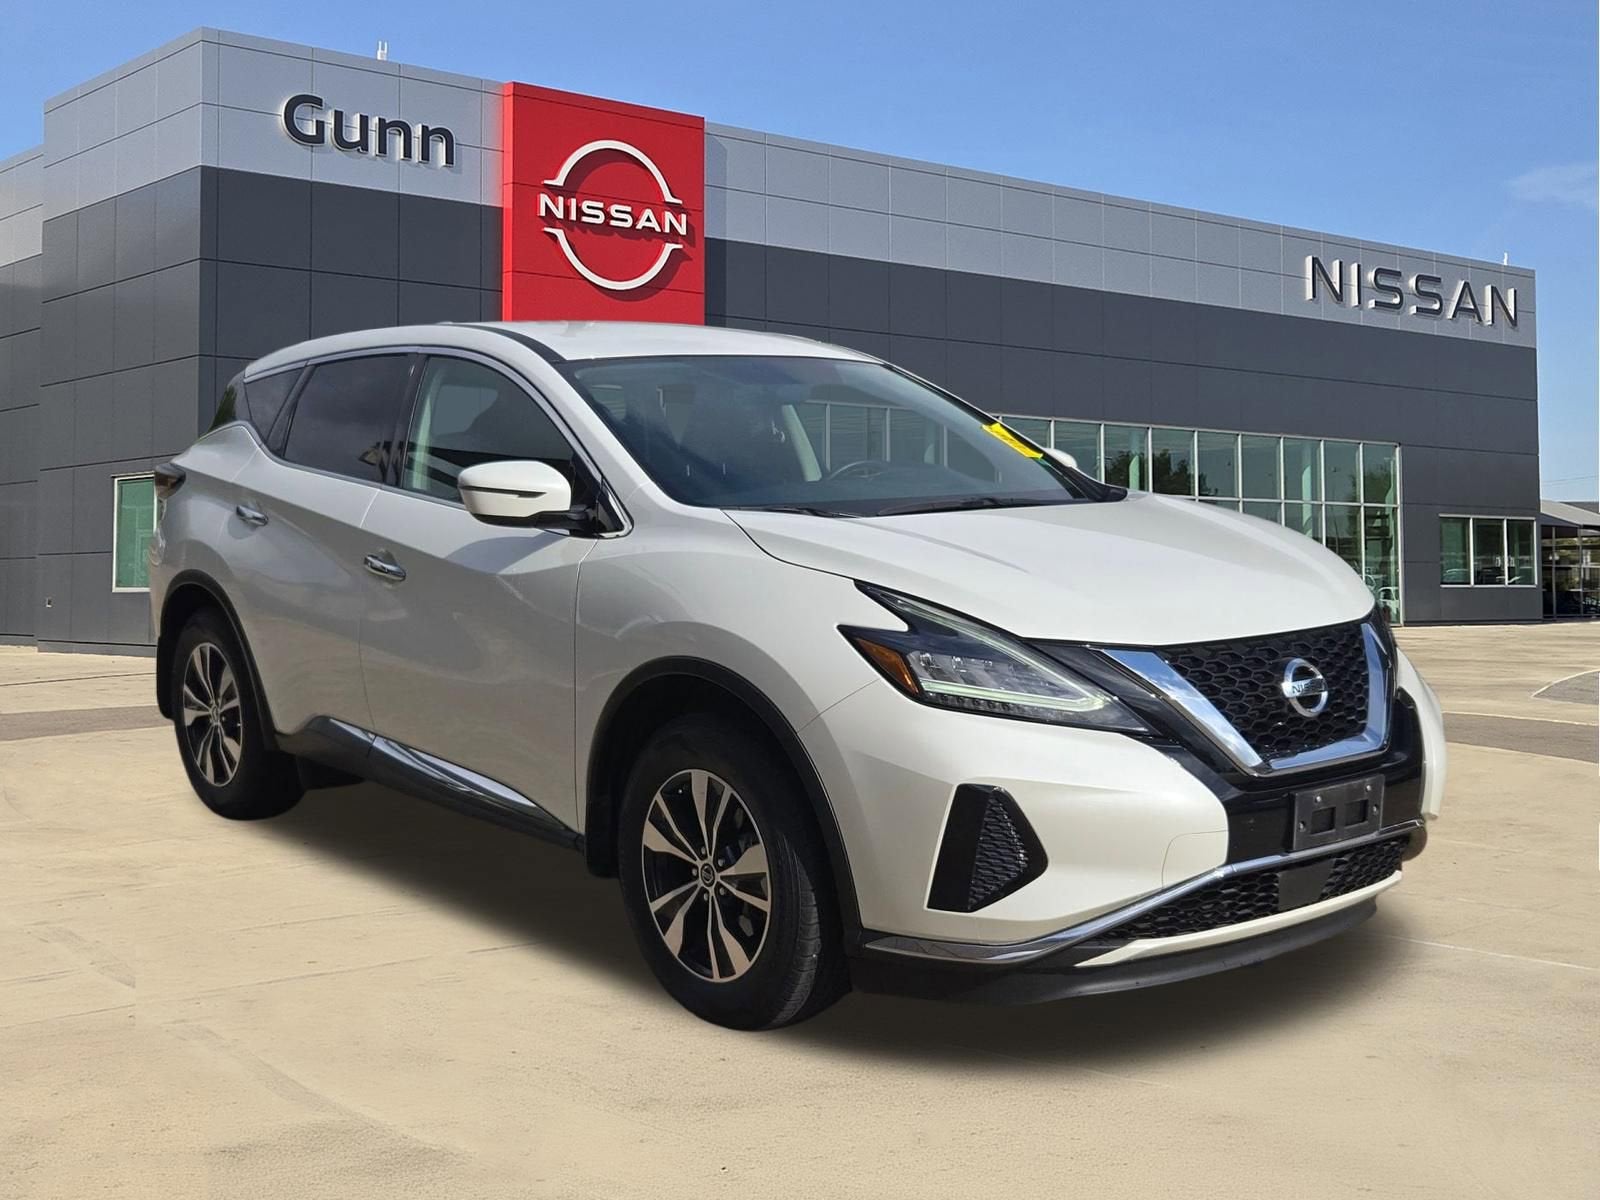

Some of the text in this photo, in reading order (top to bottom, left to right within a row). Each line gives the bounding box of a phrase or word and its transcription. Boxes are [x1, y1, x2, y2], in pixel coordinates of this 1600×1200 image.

[282, 94, 454, 168] Gunn
[538, 192, 687, 236] NISSAN
[1305, 255, 1518, 327] NISSAN
